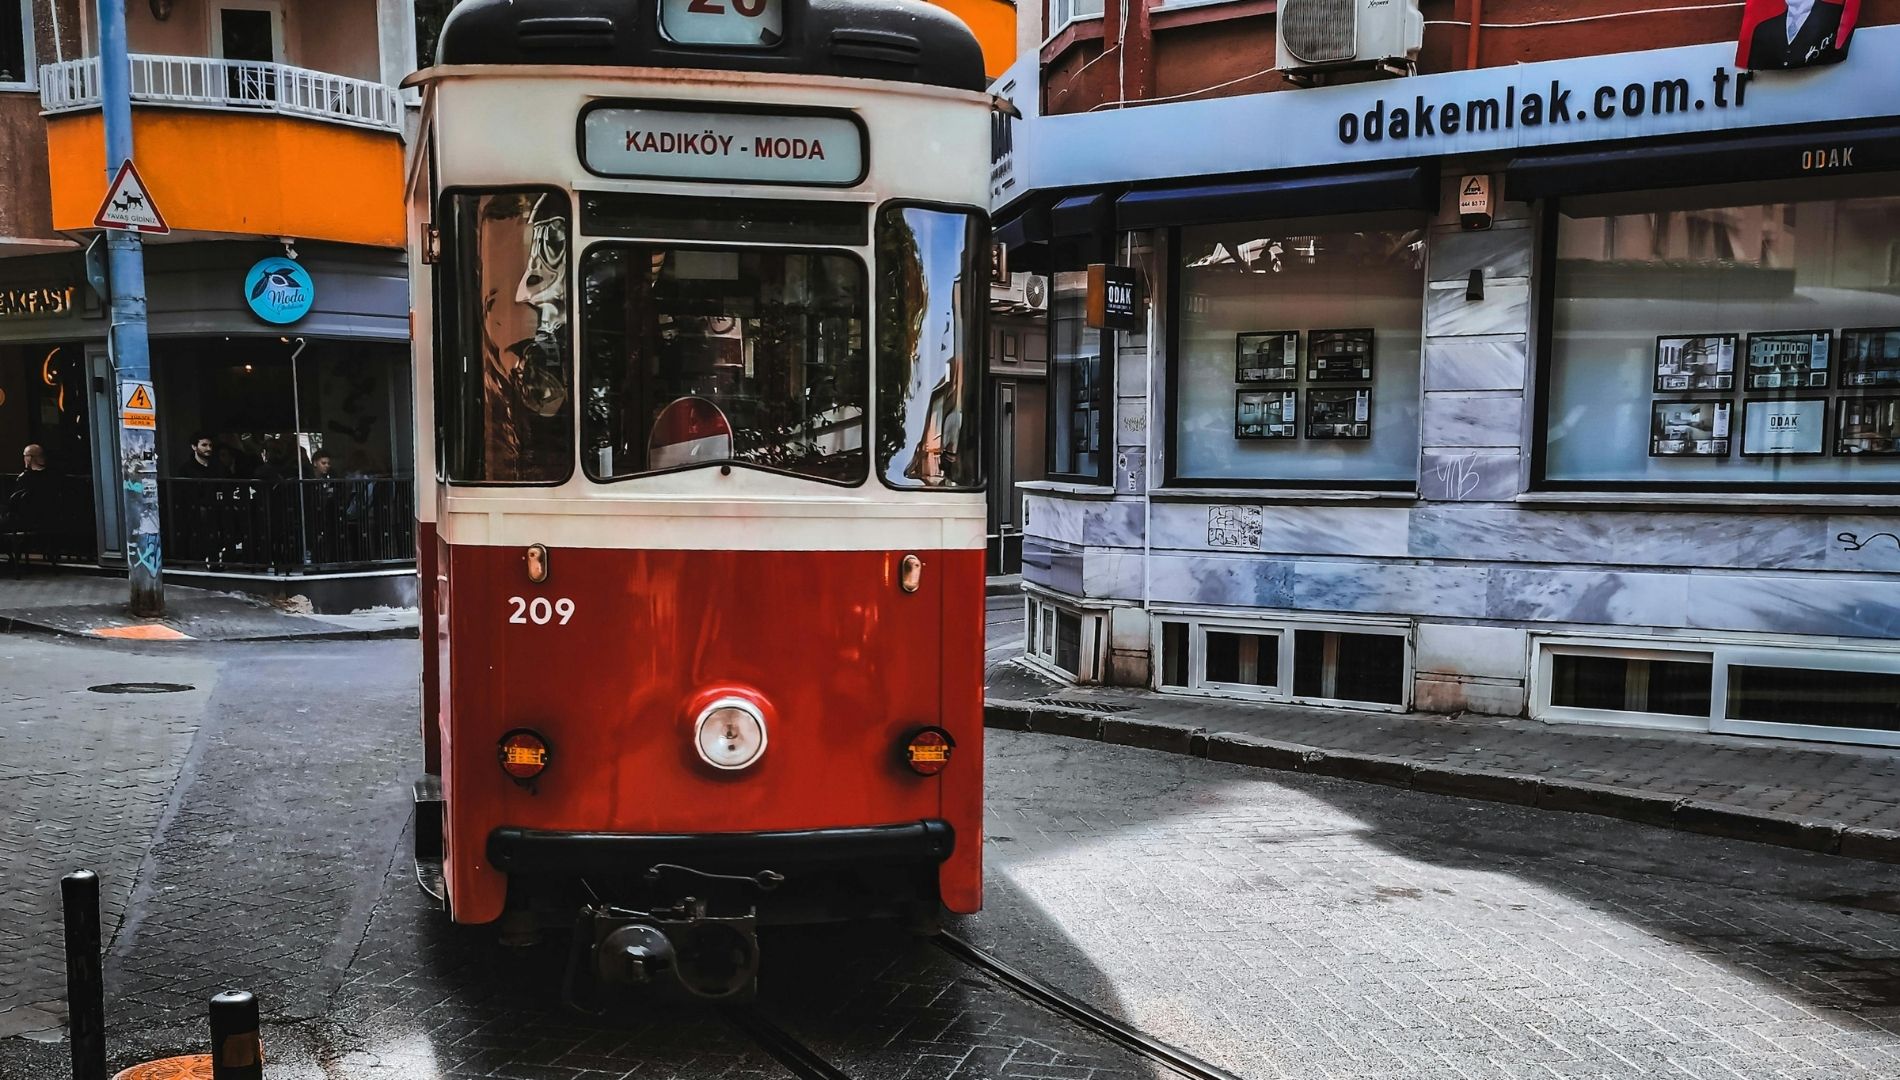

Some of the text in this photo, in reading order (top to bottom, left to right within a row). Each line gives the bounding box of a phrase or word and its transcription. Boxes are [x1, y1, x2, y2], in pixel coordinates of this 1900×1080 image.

[1338, 67, 1753, 144] odakemlak.com.tr
[626, 130, 733, 156] KADIKÖY
[755, 137, 824, 160] MODA
[1802, 147, 1854, 170] ODAK
[268, 288, 305, 307] Moda
[1109, 286, 1131, 305] ODAK
[1770, 416, 1798, 427] ODAK
[508, 596, 575, 625] 209
